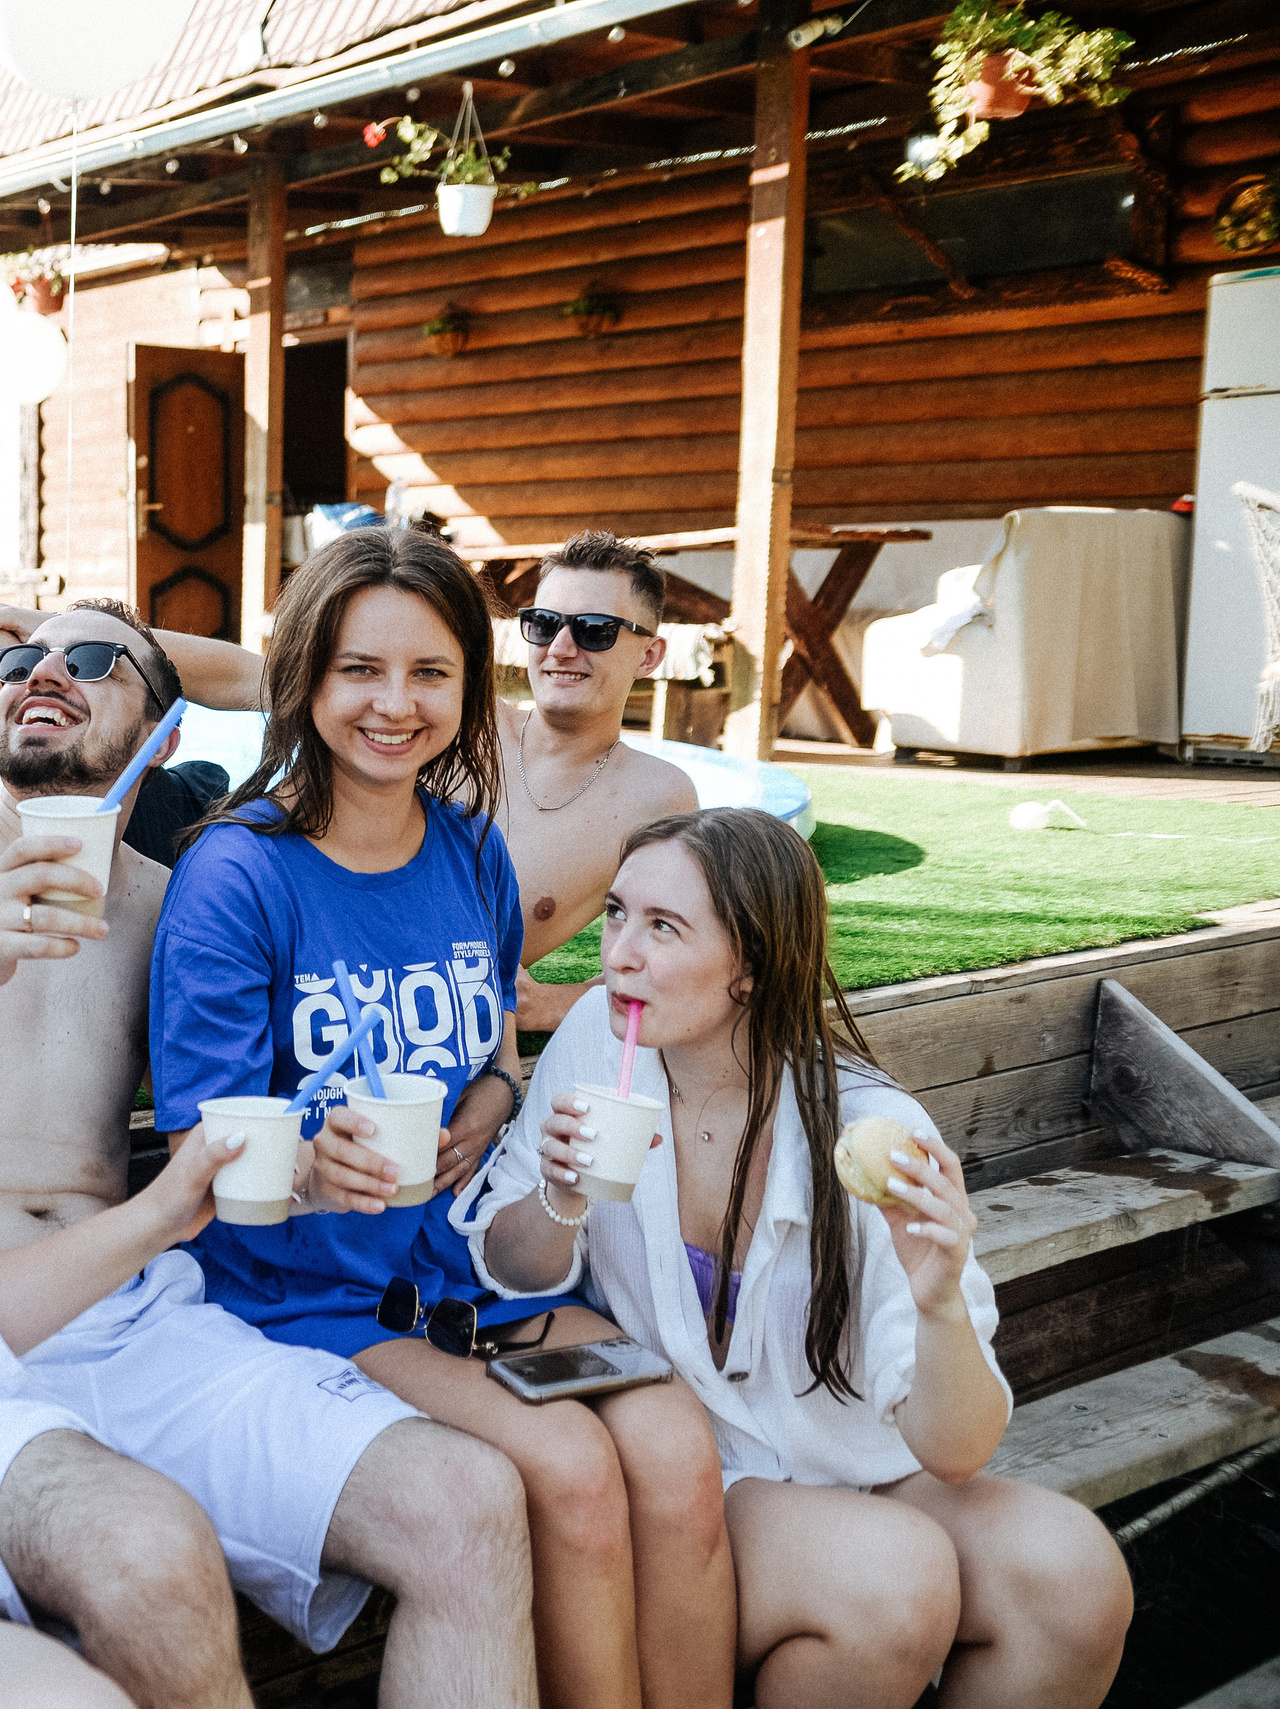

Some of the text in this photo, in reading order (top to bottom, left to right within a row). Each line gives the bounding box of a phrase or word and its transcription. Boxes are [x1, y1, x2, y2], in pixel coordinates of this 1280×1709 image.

[292, 970, 502, 1075] GOOD
[310, 1087, 343, 1102] NOUGH
[304, 1106, 332, 1120] FIN
